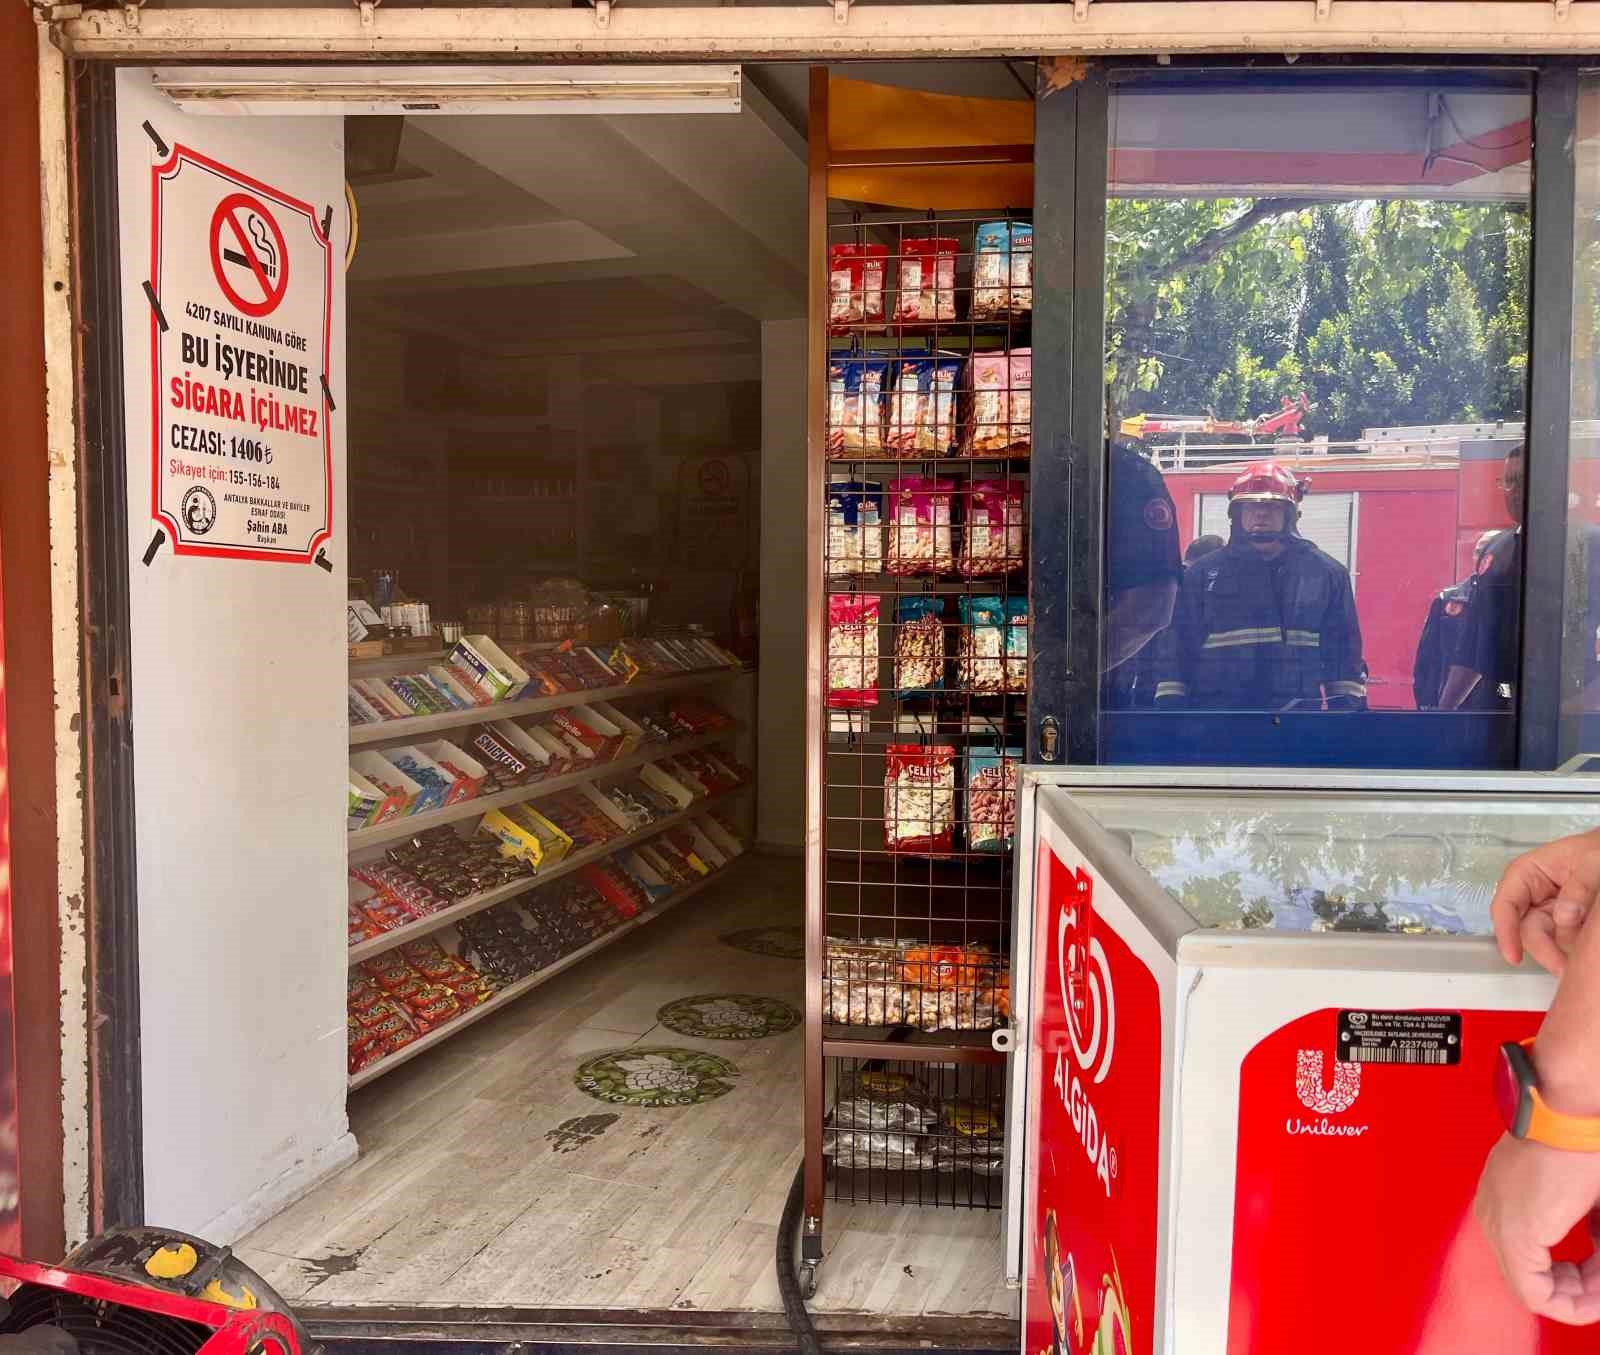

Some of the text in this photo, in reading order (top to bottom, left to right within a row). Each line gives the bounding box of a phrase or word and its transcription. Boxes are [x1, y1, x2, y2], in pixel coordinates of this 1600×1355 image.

[186, 301, 307, 352] 4207 SAYILI KANUNA GÖRE
[182, 332, 308, 395] BU İŞYERİNDE
[171, 371, 318, 437] SİGARA İÇİLMEZ
[171, 424, 226, 456] CEZASI:
[169, 458, 280, 490] Şikayet için: 155-156-184
[223, 493, 249, 504] ANTALYA
[249, 497, 281, 508] BAKKALLAR
[281, 501, 289, 510] VE
[247, 520, 288, 536] Şahin ABA
[463, 650, 480, 668] POLO
[477, 734, 523, 774] SNICKERS
[1286, 1118, 1369, 1137] Unilever
